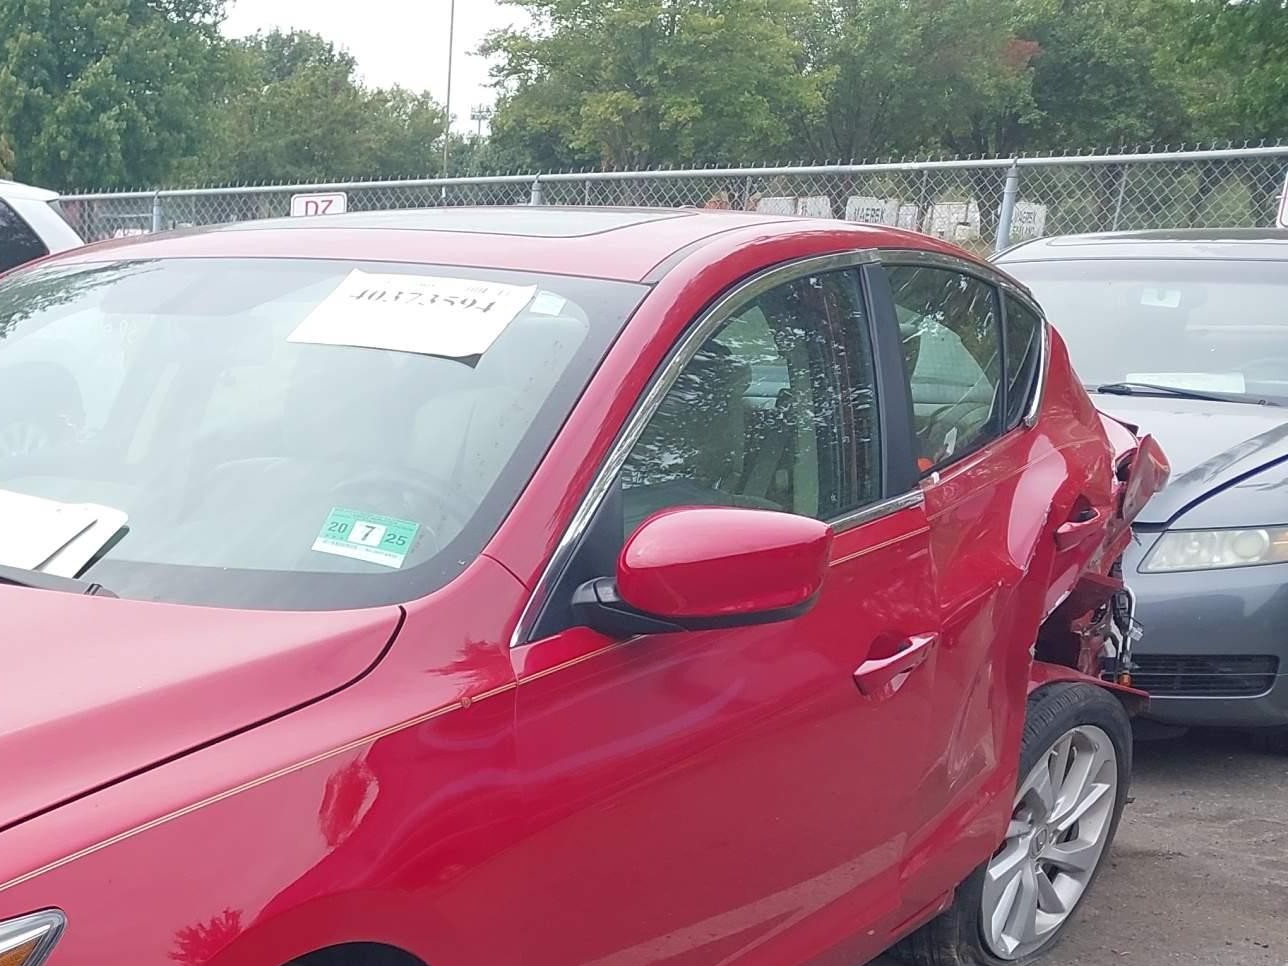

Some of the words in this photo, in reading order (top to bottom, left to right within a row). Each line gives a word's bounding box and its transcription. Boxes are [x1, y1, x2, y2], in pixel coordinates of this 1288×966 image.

[304, 199, 334, 217] DZ
[327, 521, 349, 534] 20
[361, 524, 377, 542] 7
[384, 533, 409, 546] 25
